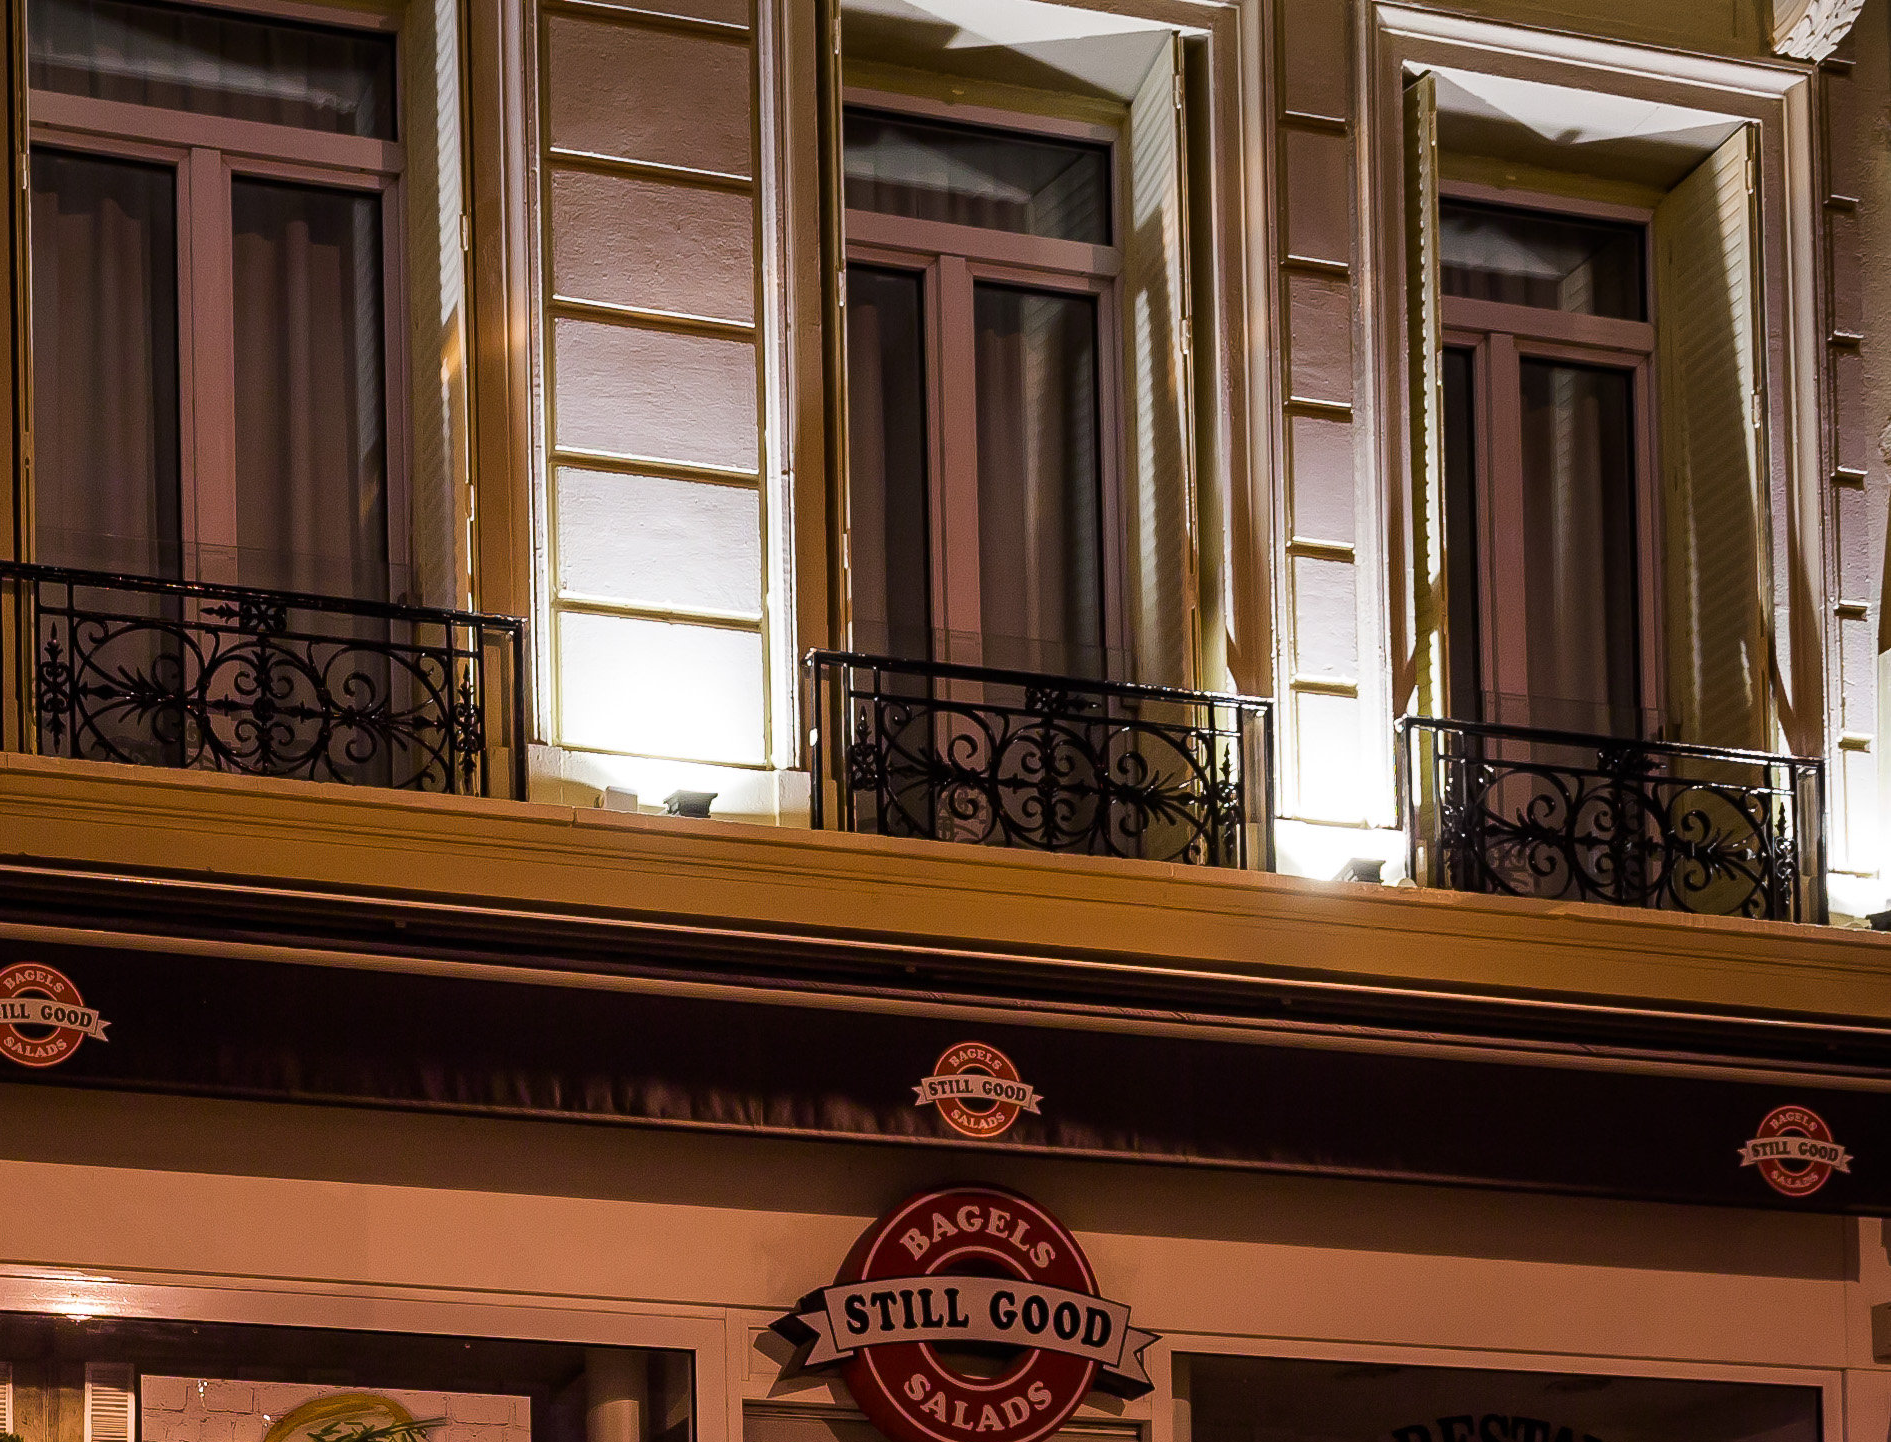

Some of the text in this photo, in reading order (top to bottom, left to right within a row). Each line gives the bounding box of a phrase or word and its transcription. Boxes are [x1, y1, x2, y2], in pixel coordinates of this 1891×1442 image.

[3, 970, 65, 994] BAGELS
[40, 1005, 92, 1028] GOOD
[3, 1036, 67, 1058] SALADS
[949, 1048, 1003, 1070] BAGELS
[928, 1079, 1027, 1102] STILL GOOD
[951, 1109, 1005, 1129] SALADS
[1769, 1111, 1818, 1131] BAGELS
[1751, 1141, 1839, 1162] STILL GOOD
[899, 1204, 1056, 1269] BAGELS
[844, 1287, 1113, 1349] STILL GOOD
[903, 1373, 1053, 1433] SALADS
